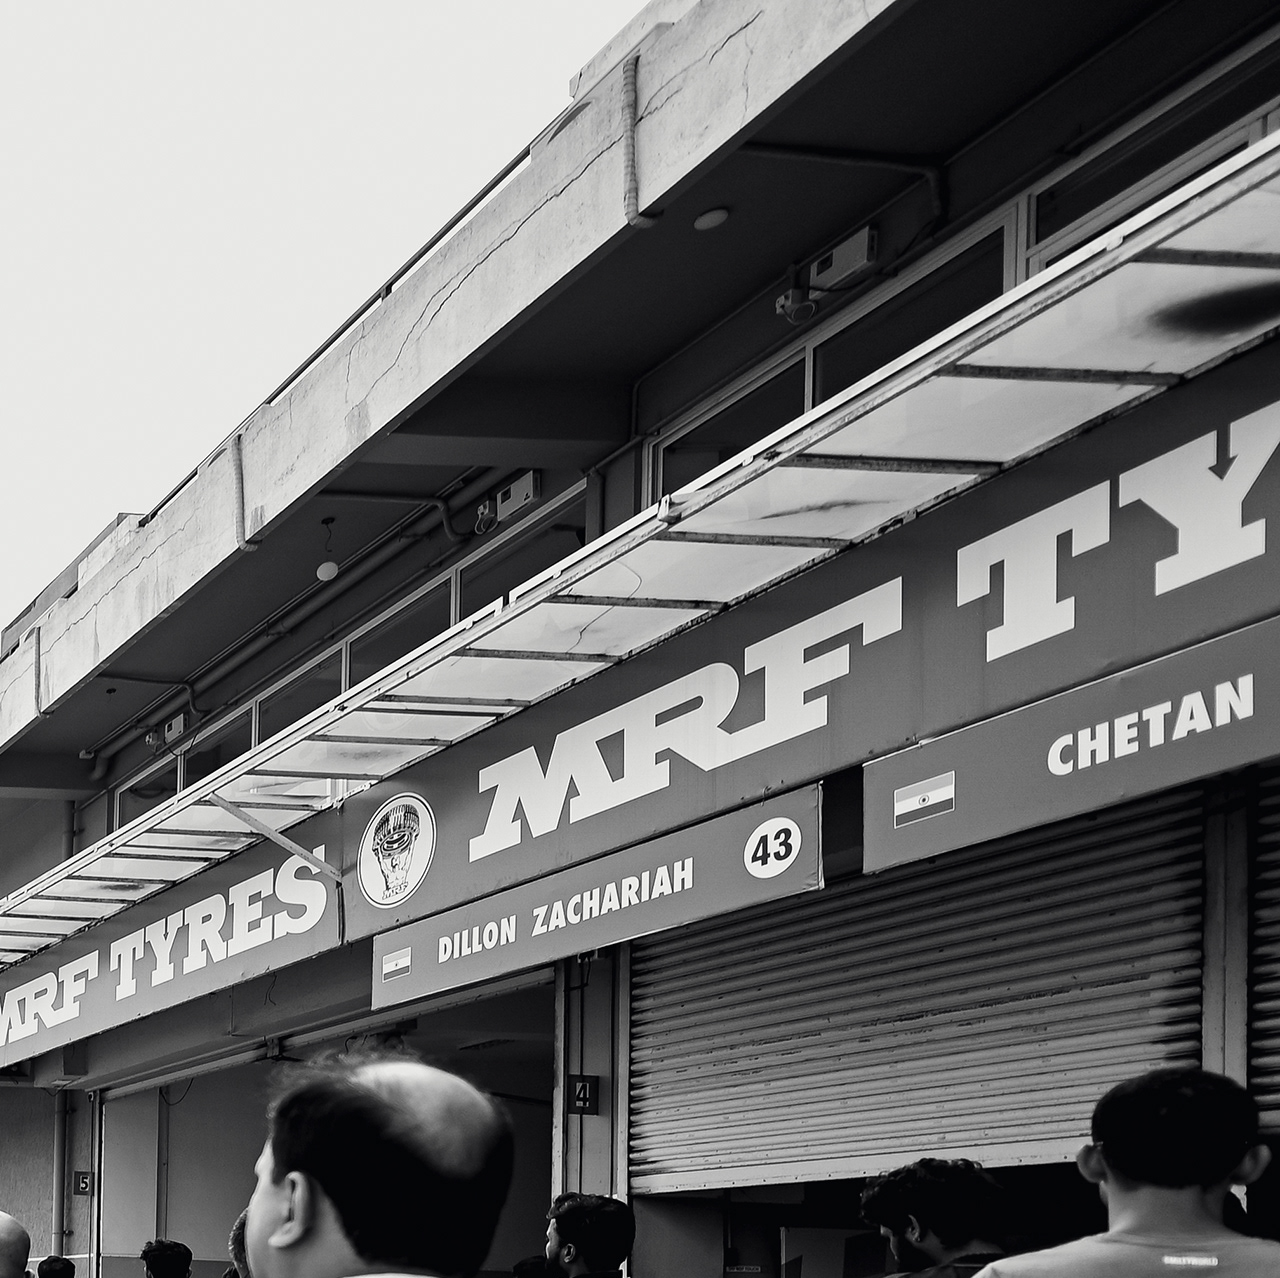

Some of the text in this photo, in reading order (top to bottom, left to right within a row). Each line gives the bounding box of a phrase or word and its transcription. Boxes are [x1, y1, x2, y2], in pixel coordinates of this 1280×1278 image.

[468, 398, 1280, 864] MRF TY
[1047, 673, 1254, 776] CHETAN
[750, 827, 793, 867] 43
[110, 844, 327, 1002] TYRES
[438, 857, 694, 965] DILLON ZACHARIAH
[575, 1082, 589, 1107] 4
[79, 1175, 90, 1191] 5
